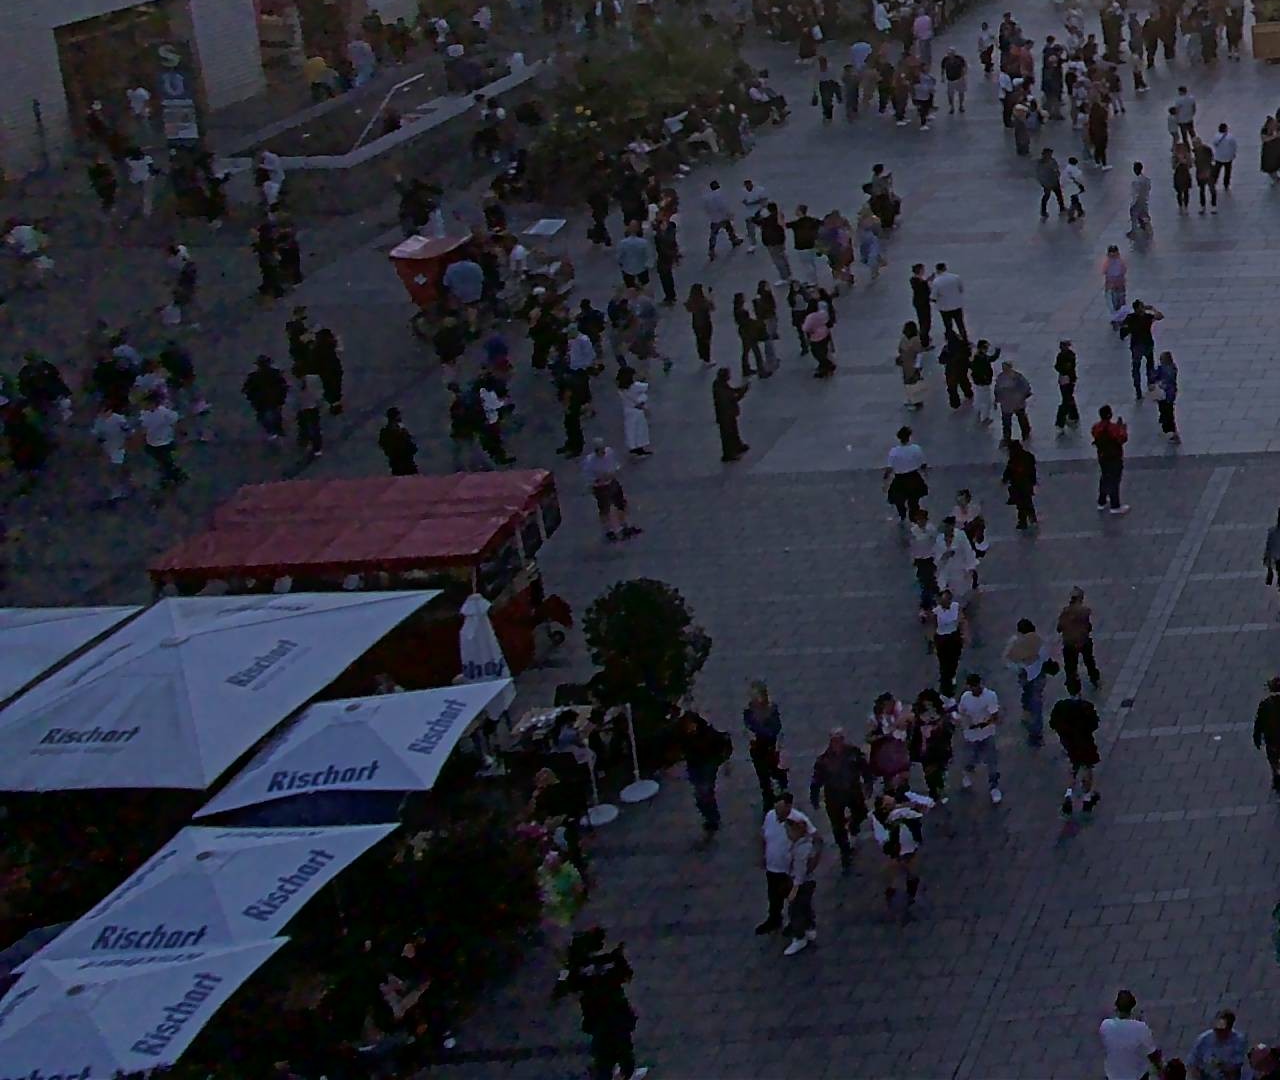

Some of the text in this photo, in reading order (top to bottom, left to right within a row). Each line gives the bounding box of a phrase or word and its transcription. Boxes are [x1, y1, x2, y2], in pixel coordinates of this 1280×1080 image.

[158, 44, 181, 68] S
[39, 726, 141, 744] Rischart
[408, 698, 467, 754] Rischart
[267, 760, 380, 792] Rischart
[242, 848, 335, 921] Rischart
[91, 923, 208, 951] Rischart
[130, 971, 223, 1056] Rischart
